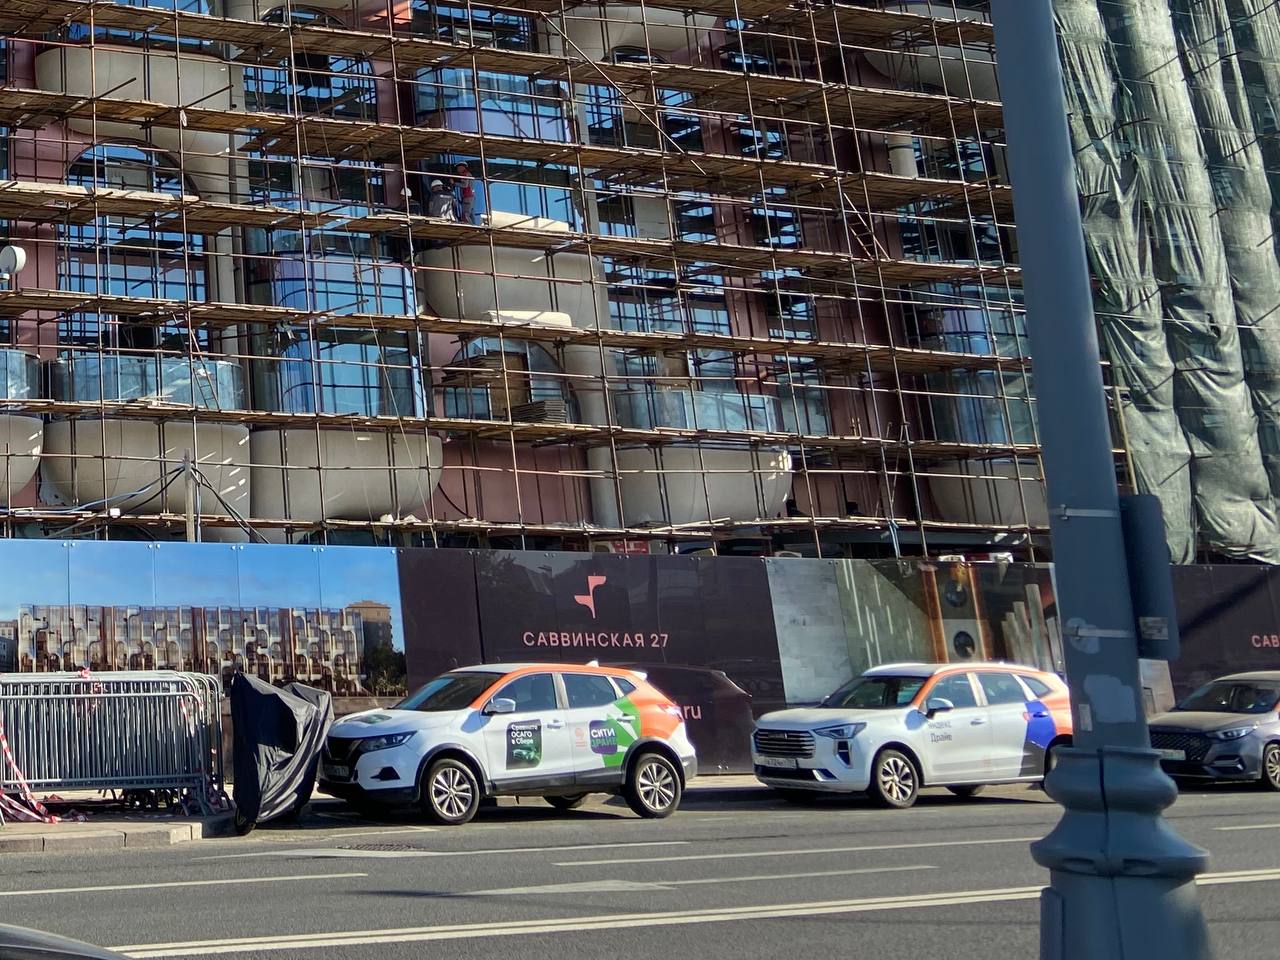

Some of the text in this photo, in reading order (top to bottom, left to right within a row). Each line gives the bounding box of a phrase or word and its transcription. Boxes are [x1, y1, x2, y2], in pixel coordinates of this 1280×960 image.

[523, 631, 668, 648] САВВИНСКАЯ 27
[511, 730, 533, 738] ОСАГО
[591, 727, 616, 738] СИТИ
